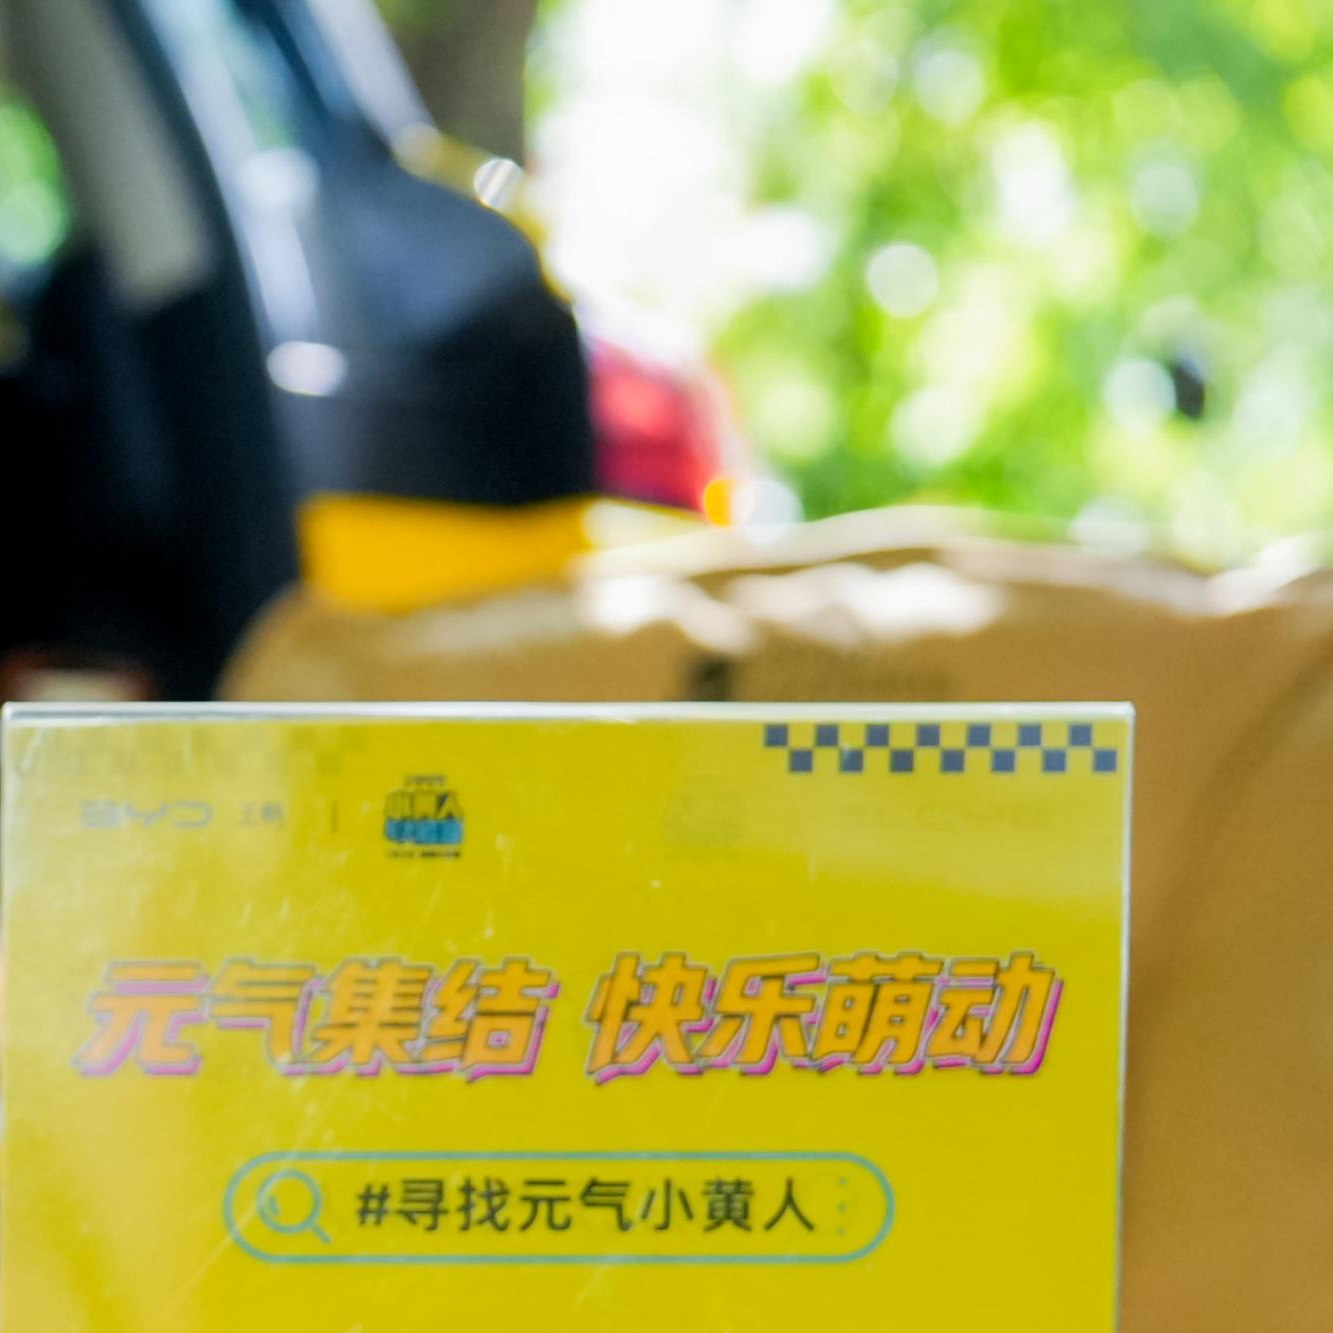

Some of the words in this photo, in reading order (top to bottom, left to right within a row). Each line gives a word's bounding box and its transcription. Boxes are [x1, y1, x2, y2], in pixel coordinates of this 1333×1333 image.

[74, 957, 559, 1082] 元气集结
[584, 950, 1065, 1084] 快乐萌动
[356, 1177, 816, 1234] #寻找元气小黄人
